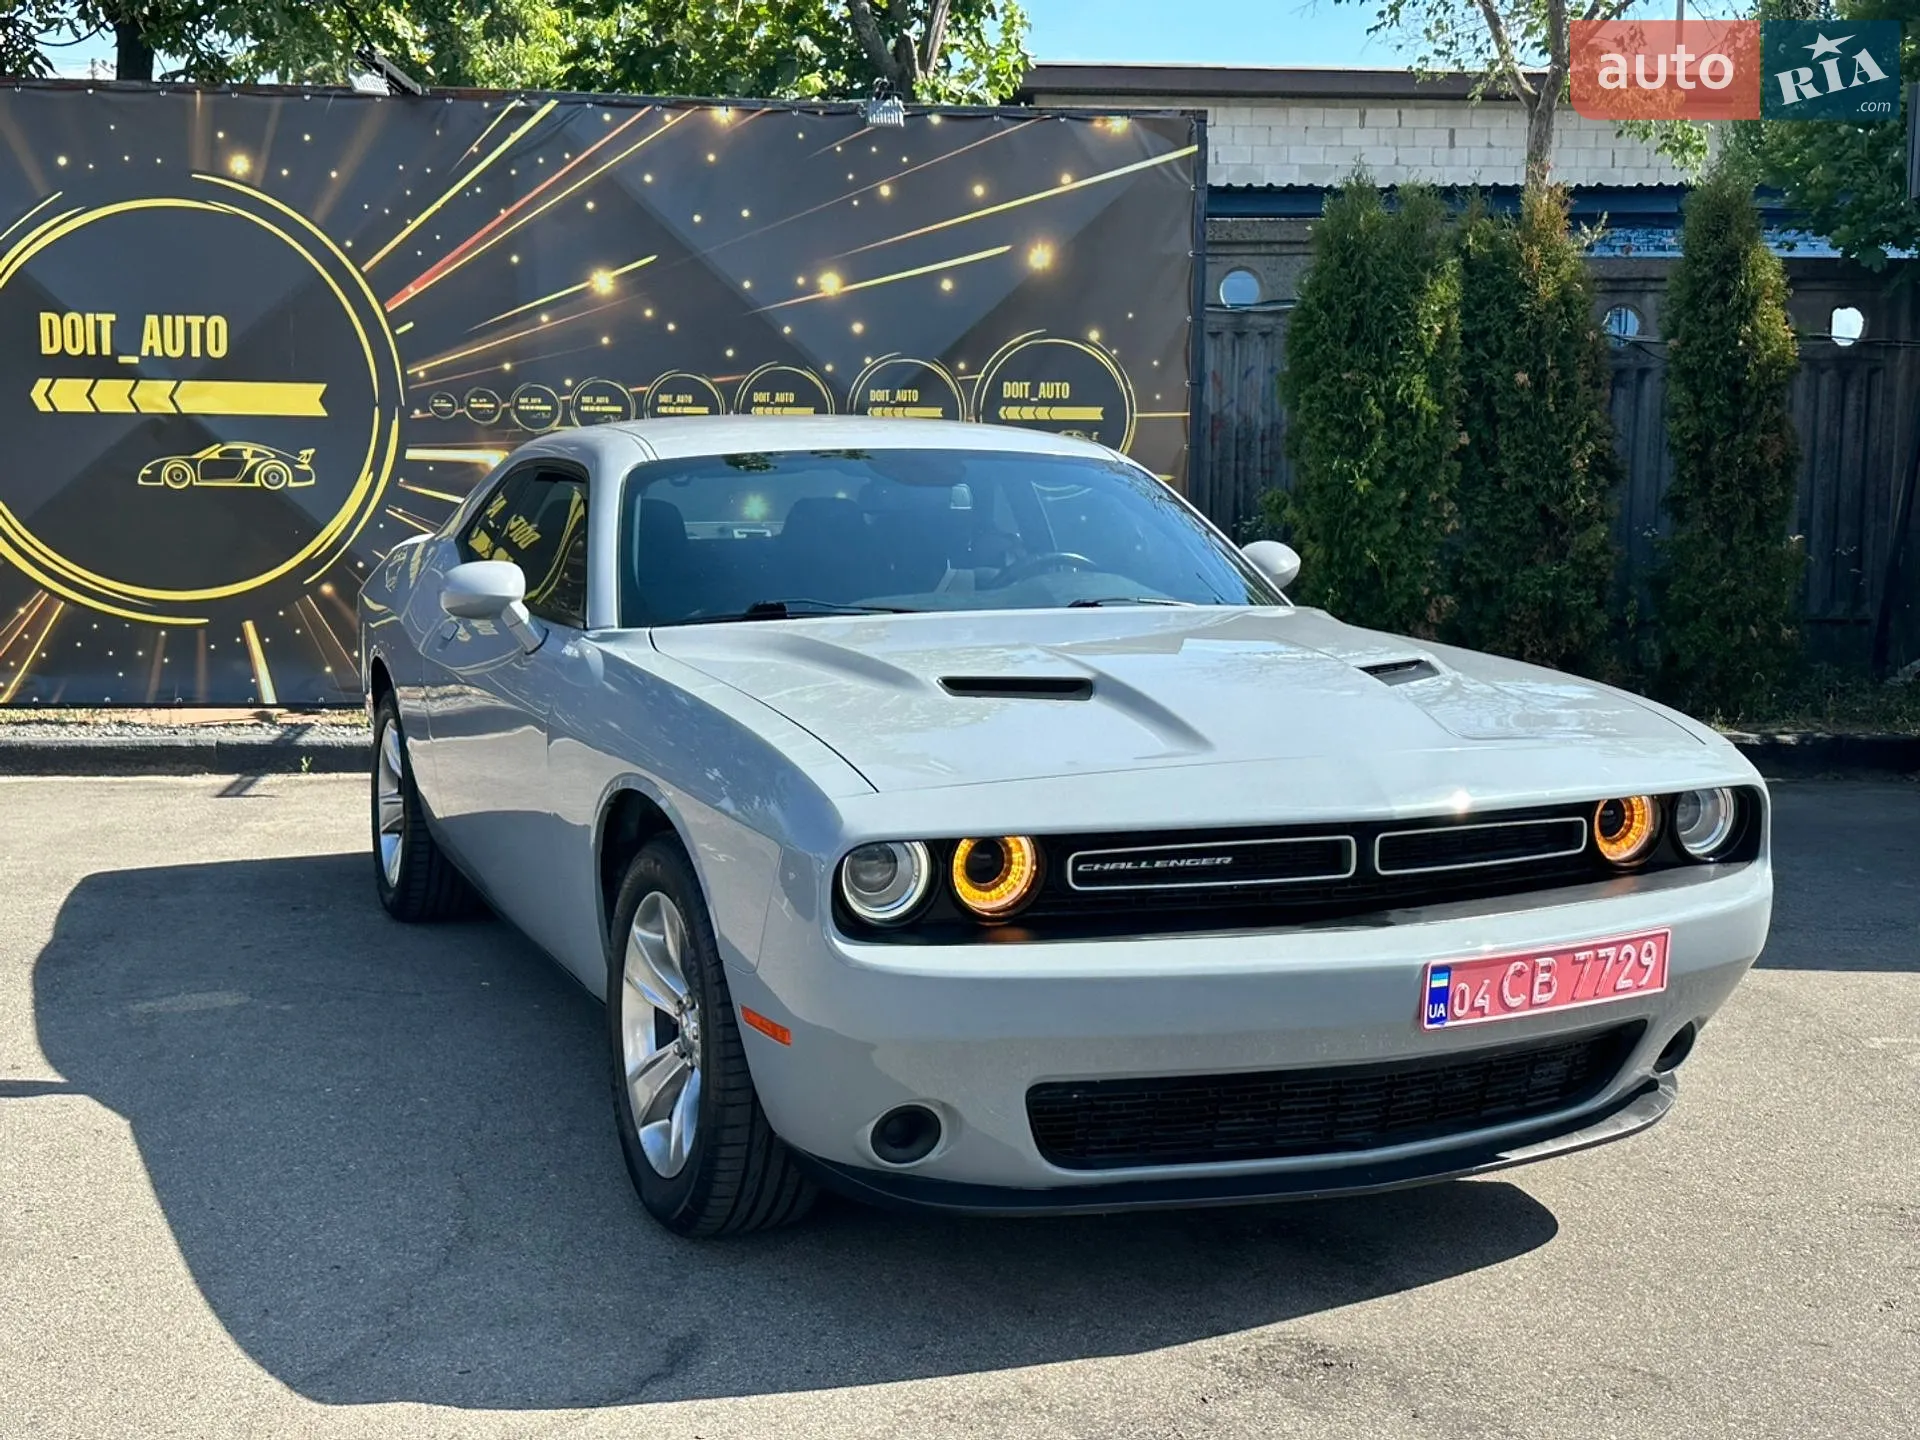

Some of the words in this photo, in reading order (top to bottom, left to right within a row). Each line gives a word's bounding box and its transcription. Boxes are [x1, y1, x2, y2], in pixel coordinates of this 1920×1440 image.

[39, 311, 228, 364] DOIT_AUTO
[753, 391, 795, 405] DOIT_AUTO
[869, 388, 919, 404] DOIT_AUTO
[1002, 381, 1070, 401] DOIT_AUTO
[1077, 856, 1233, 872] CHALLENGER
[1453, 979, 1490, 1018] 04
[1502, 957, 1557, 1008] CB
[1572, 940, 1657, 1001] 7729
[1428, 1002, 1446, 1019] UA
